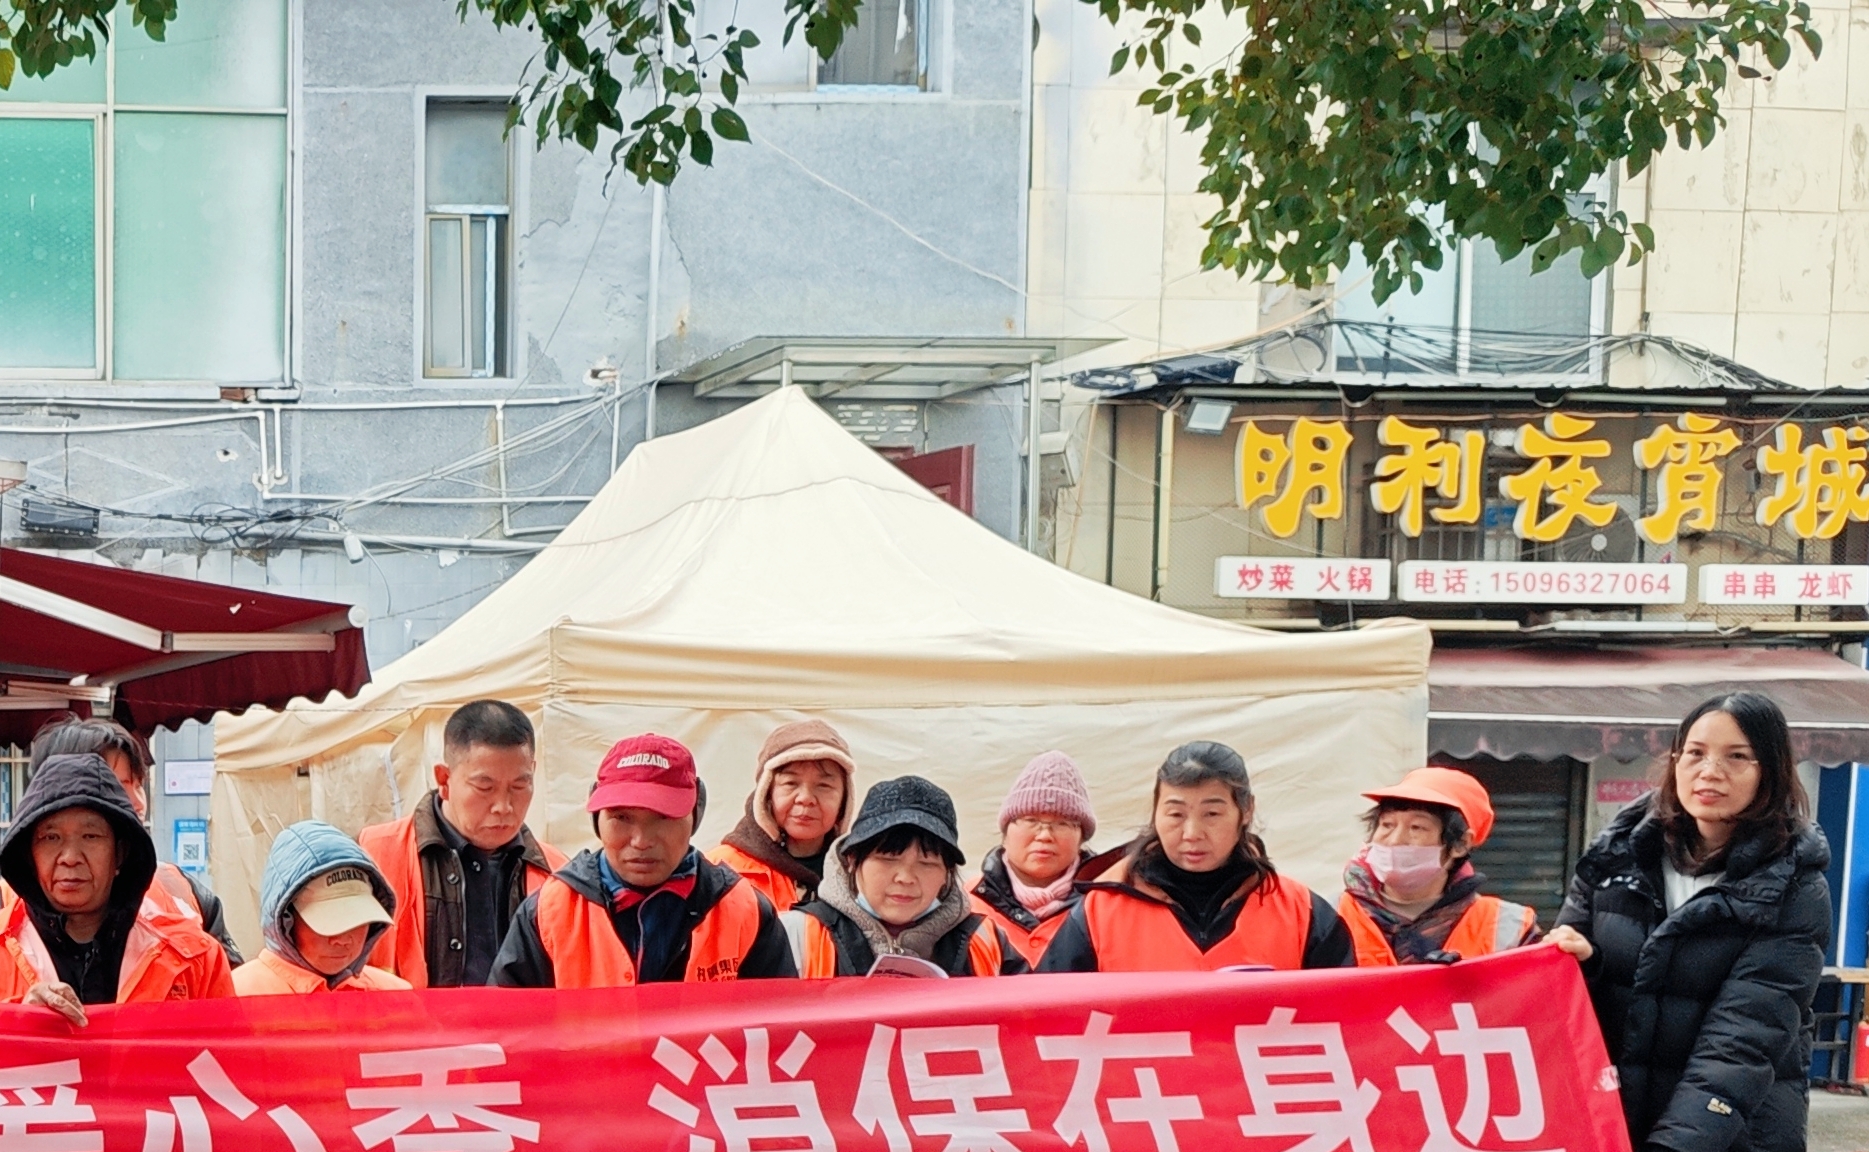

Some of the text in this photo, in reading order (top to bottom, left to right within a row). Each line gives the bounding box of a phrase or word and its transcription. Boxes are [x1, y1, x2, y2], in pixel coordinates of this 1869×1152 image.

[1235, 412, 1869, 545] 明利夜宵城
[1236, 563, 1374, 594] 炒菜 火锅
[1723, 569, 1854, 600] 串串 龙虾
